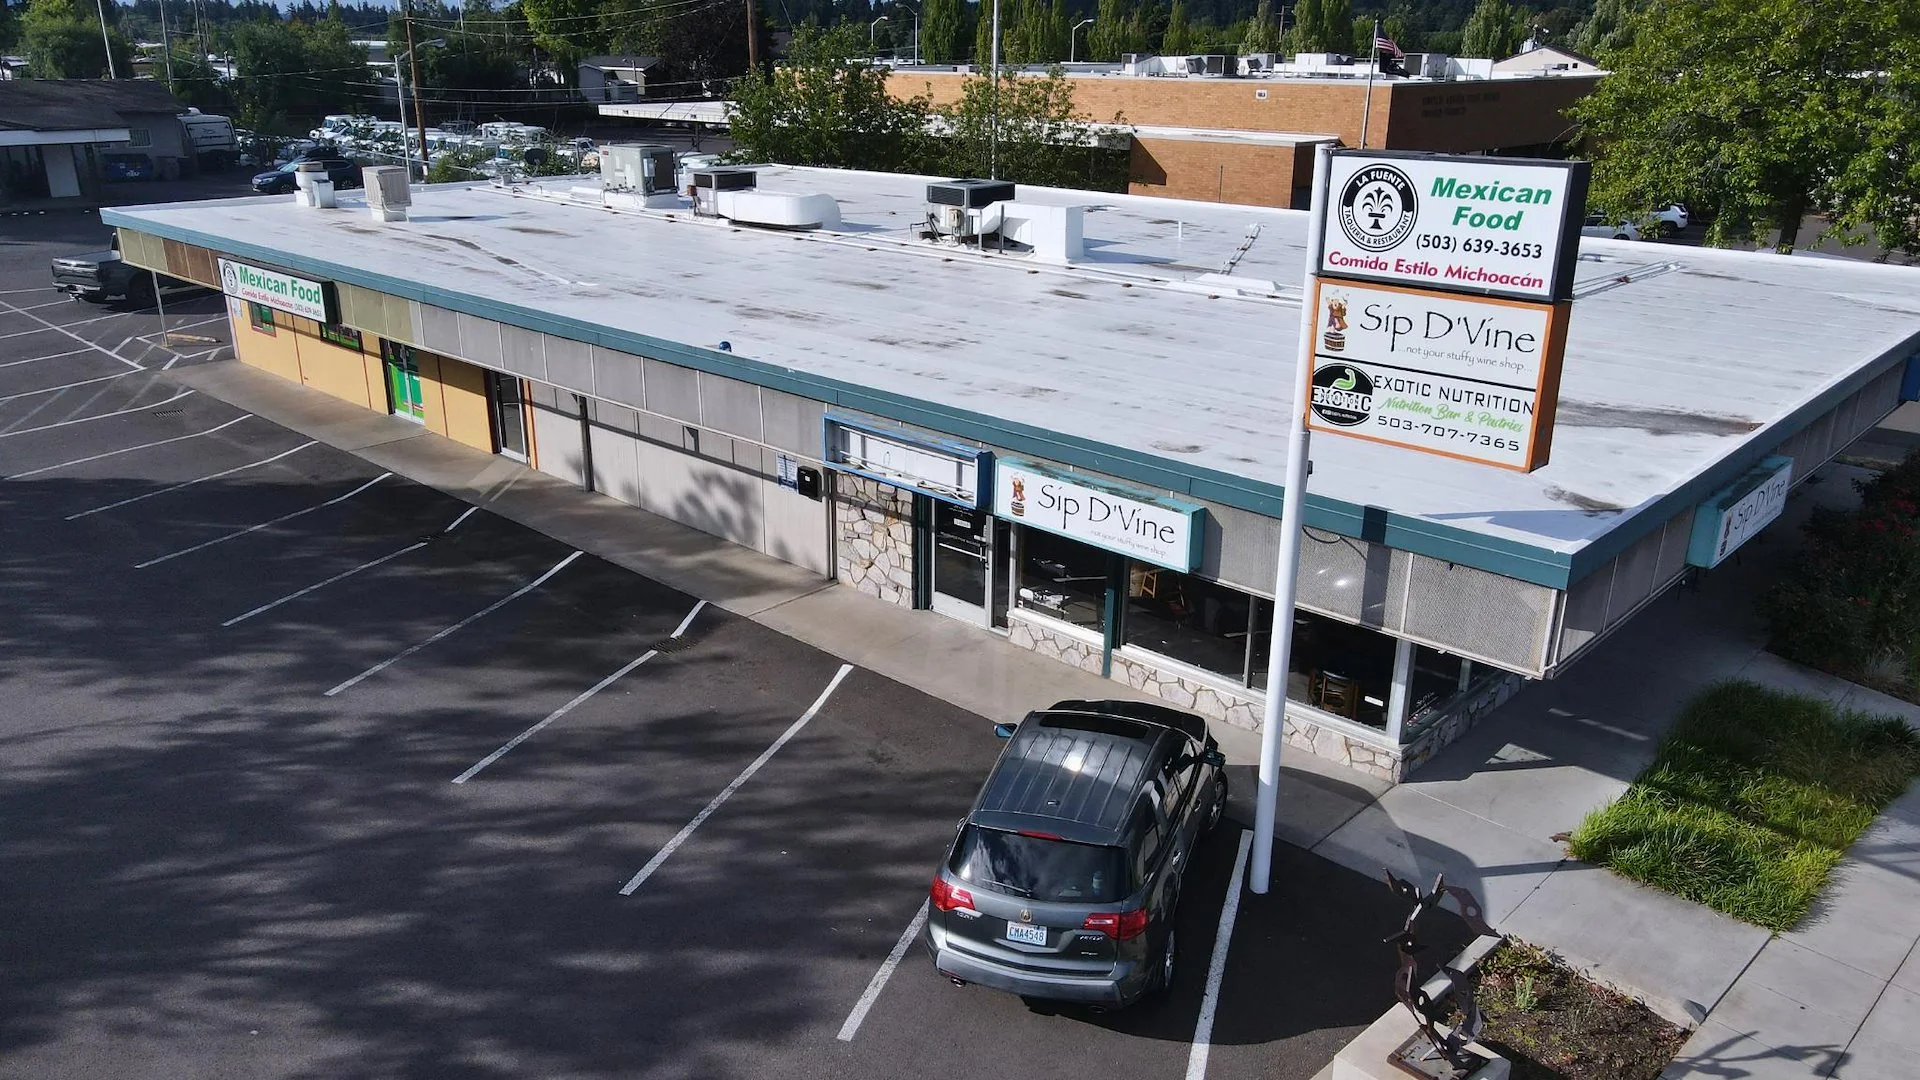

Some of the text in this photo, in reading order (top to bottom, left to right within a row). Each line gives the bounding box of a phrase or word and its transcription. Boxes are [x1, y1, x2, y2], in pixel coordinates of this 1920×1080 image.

[1355, 170, 1406, 191] LA FUENTE
[1430, 177, 1553, 205] Mexican
[1344, 209, 1366, 242] TAQUERIA
[1373, 214, 1411, 245] RESTAURANT
[1452, 206, 1524, 231] Food
[1416, 233, 1542, 258] (503) 639-3653
[239, 266, 287, 296] Mexican
[291, 280, 320, 304] Food
[1328, 251, 1544, 288] Comida Estilo Michoacán
[1360, 303, 1535, 353] Sip D'Vine
[1423, 349, 1445, 360] your
[1447, 350, 1475, 366] stuffy
[1476, 356, 1498, 366] wine
[1374, 375, 1535, 416] EXOTIC NUTRITION
[1378, 396, 1433, 415] Nutrition
[1432, 403, 1460, 420] Bar
[1464, 411, 1474, 423] &
[1478, 411, 1524, 433] Pastries
[1378, 416, 1520, 452] 503-707-7365
[1037, 484, 1176, 544] Sip D'Vine
